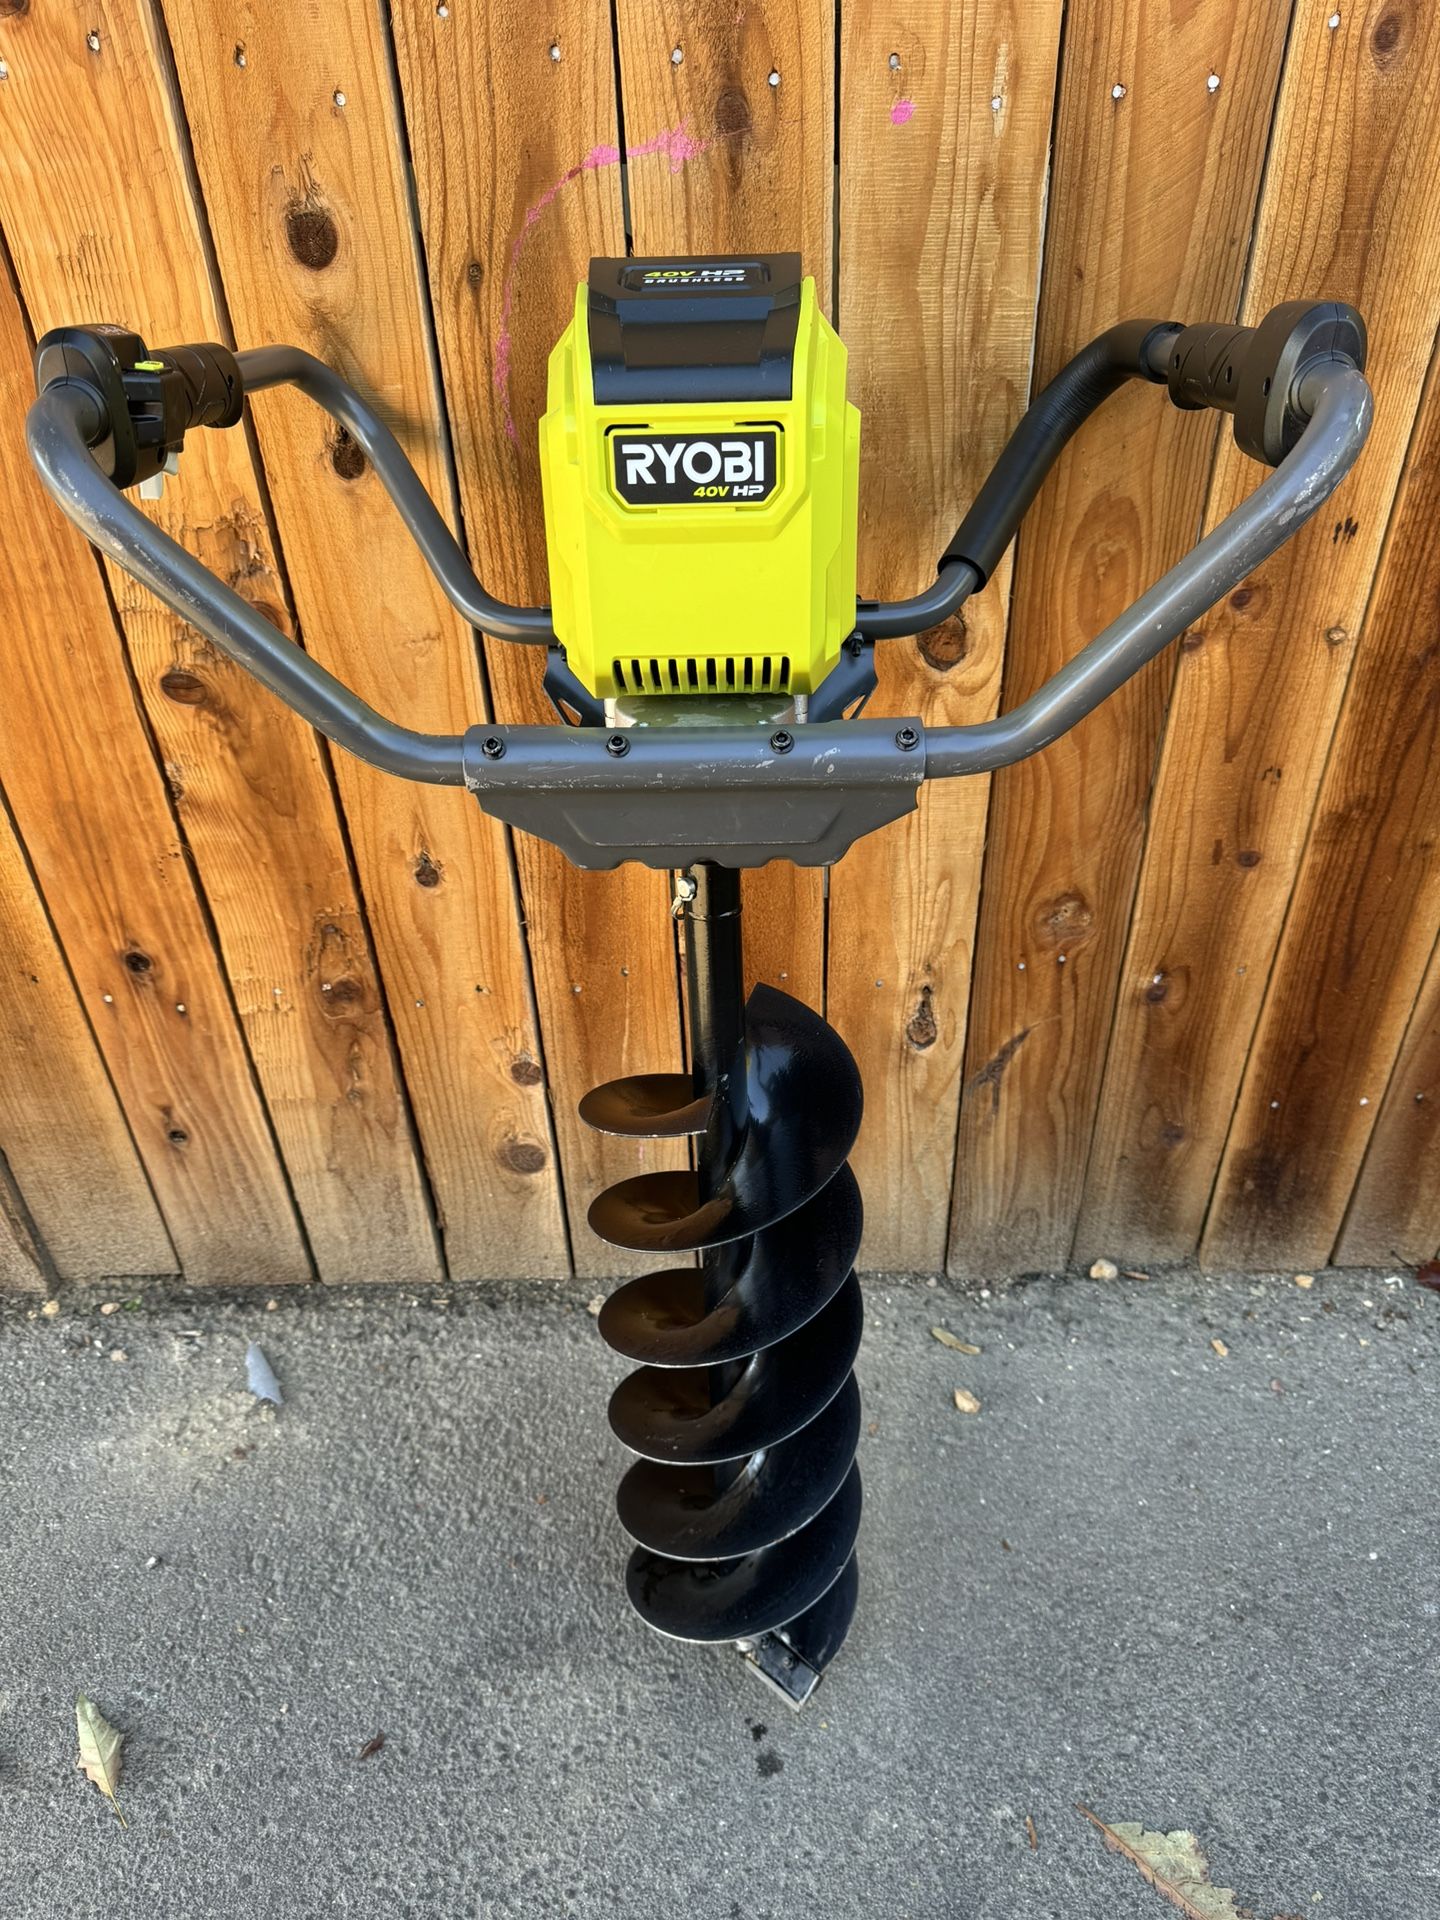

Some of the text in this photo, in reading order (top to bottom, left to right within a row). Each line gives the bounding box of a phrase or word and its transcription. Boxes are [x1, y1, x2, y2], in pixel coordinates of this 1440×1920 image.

[621, 441, 765, 484] RYOBI
[693, 485, 765, 498] 40V HP
